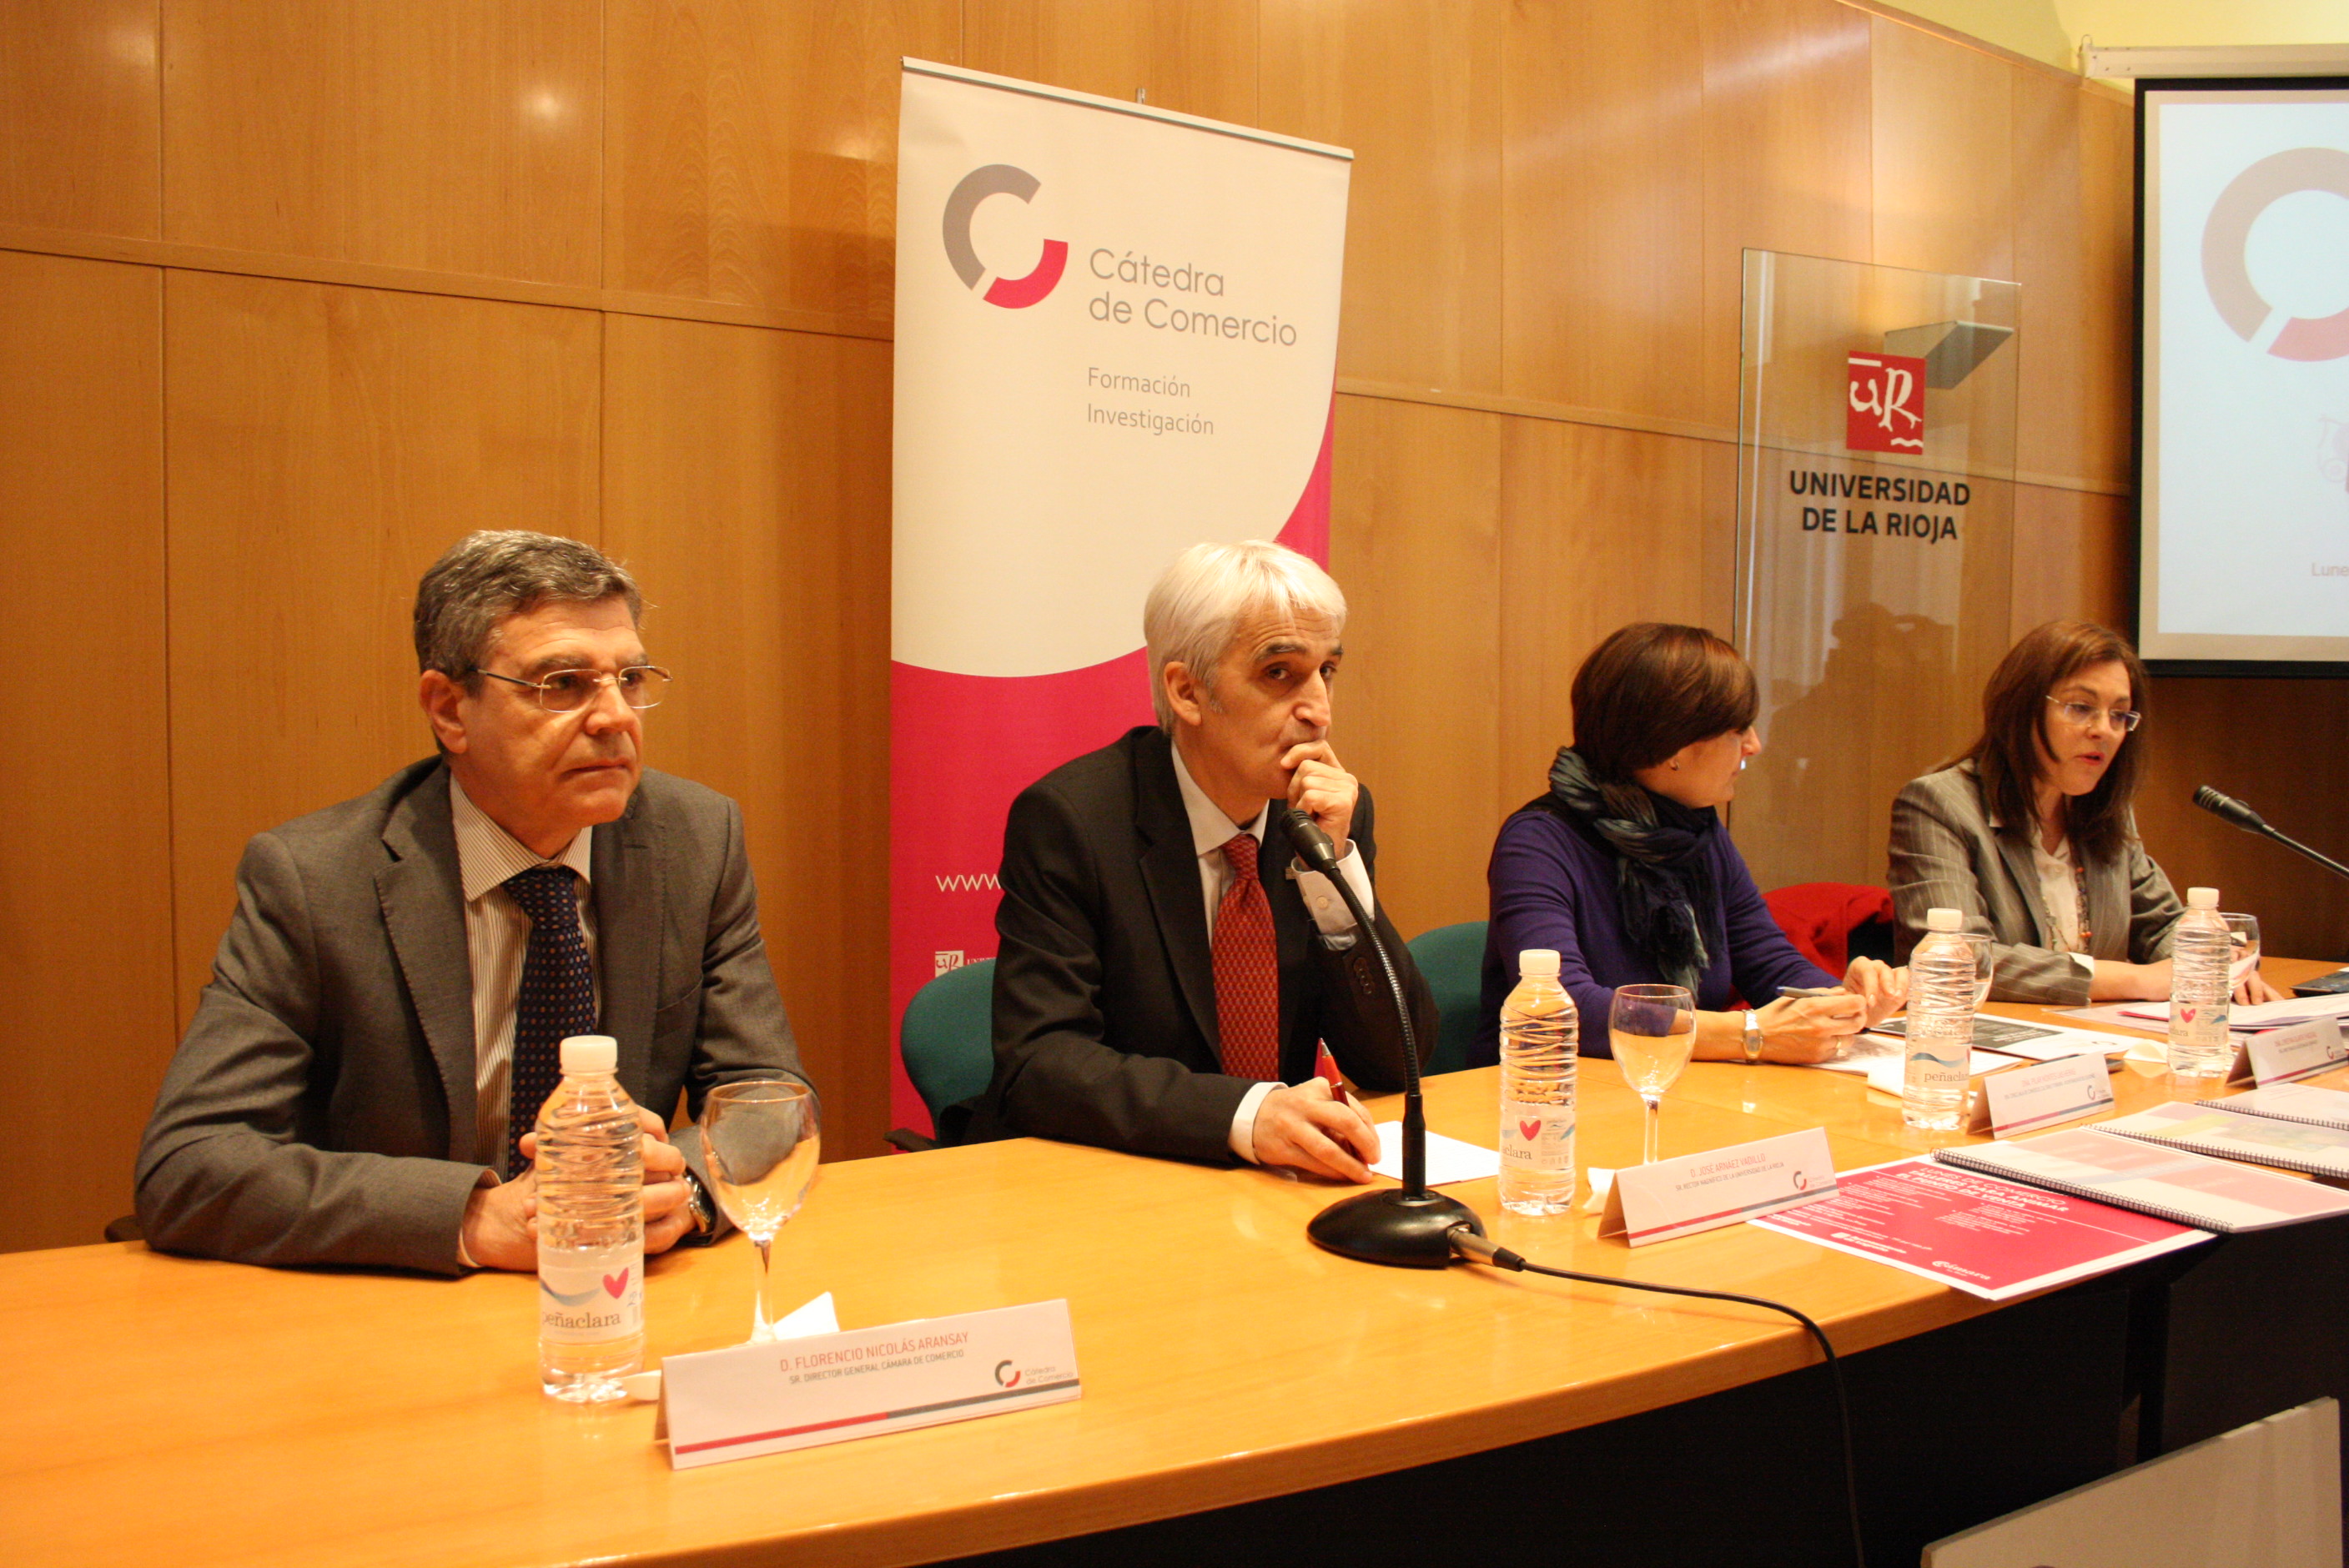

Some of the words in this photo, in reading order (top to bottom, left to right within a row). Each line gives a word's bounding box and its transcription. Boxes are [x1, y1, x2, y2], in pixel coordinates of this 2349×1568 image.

[1089, 248, 1225, 296] Cátedra
[1089, 291, 1133, 324] de
[1144, 299, 1297, 346] Comercio
[1088, 367, 1191, 398] Formación
[1087, 403, 1215, 435] Investigación
[1790, 470, 1970, 506] UNIVERSIDAD
[1803, 507, 1837, 533] DE
[1846, 510, 1878, 535] LA
[1887, 512, 1958, 544] RIOJA
[1699, 1163, 1714, 1177] JOSÉ
[1740, 1153, 1767, 1168] VADILLO
[1919, 1168, 1962, 1180] LUNES
[1984, 1183, 2065, 1205] COMERCIO
[1967, 1184, 2004, 1197] PARA
[2008, 1194, 2069, 1212] ANIMAR
[1981, 1194, 2025, 1209] VENTA
[780, 1359, 792, 1372] D.
[795, 1348, 863, 1369] FLORENCIO
[867, 1338, 916, 1359] NICOLÁS
[918, 1332, 968, 1350] ARANSAY
[789, 1375, 802, 1385] SR.
[804, 1368, 843, 1382] DIRECTOR
[844, 1362, 878, 1377] GENERAL
[881, 1356, 913, 1370] CÁMARA
[914, 1354, 923, 1364] DE
[925, 1349, 965, 1364] COMERCIO
